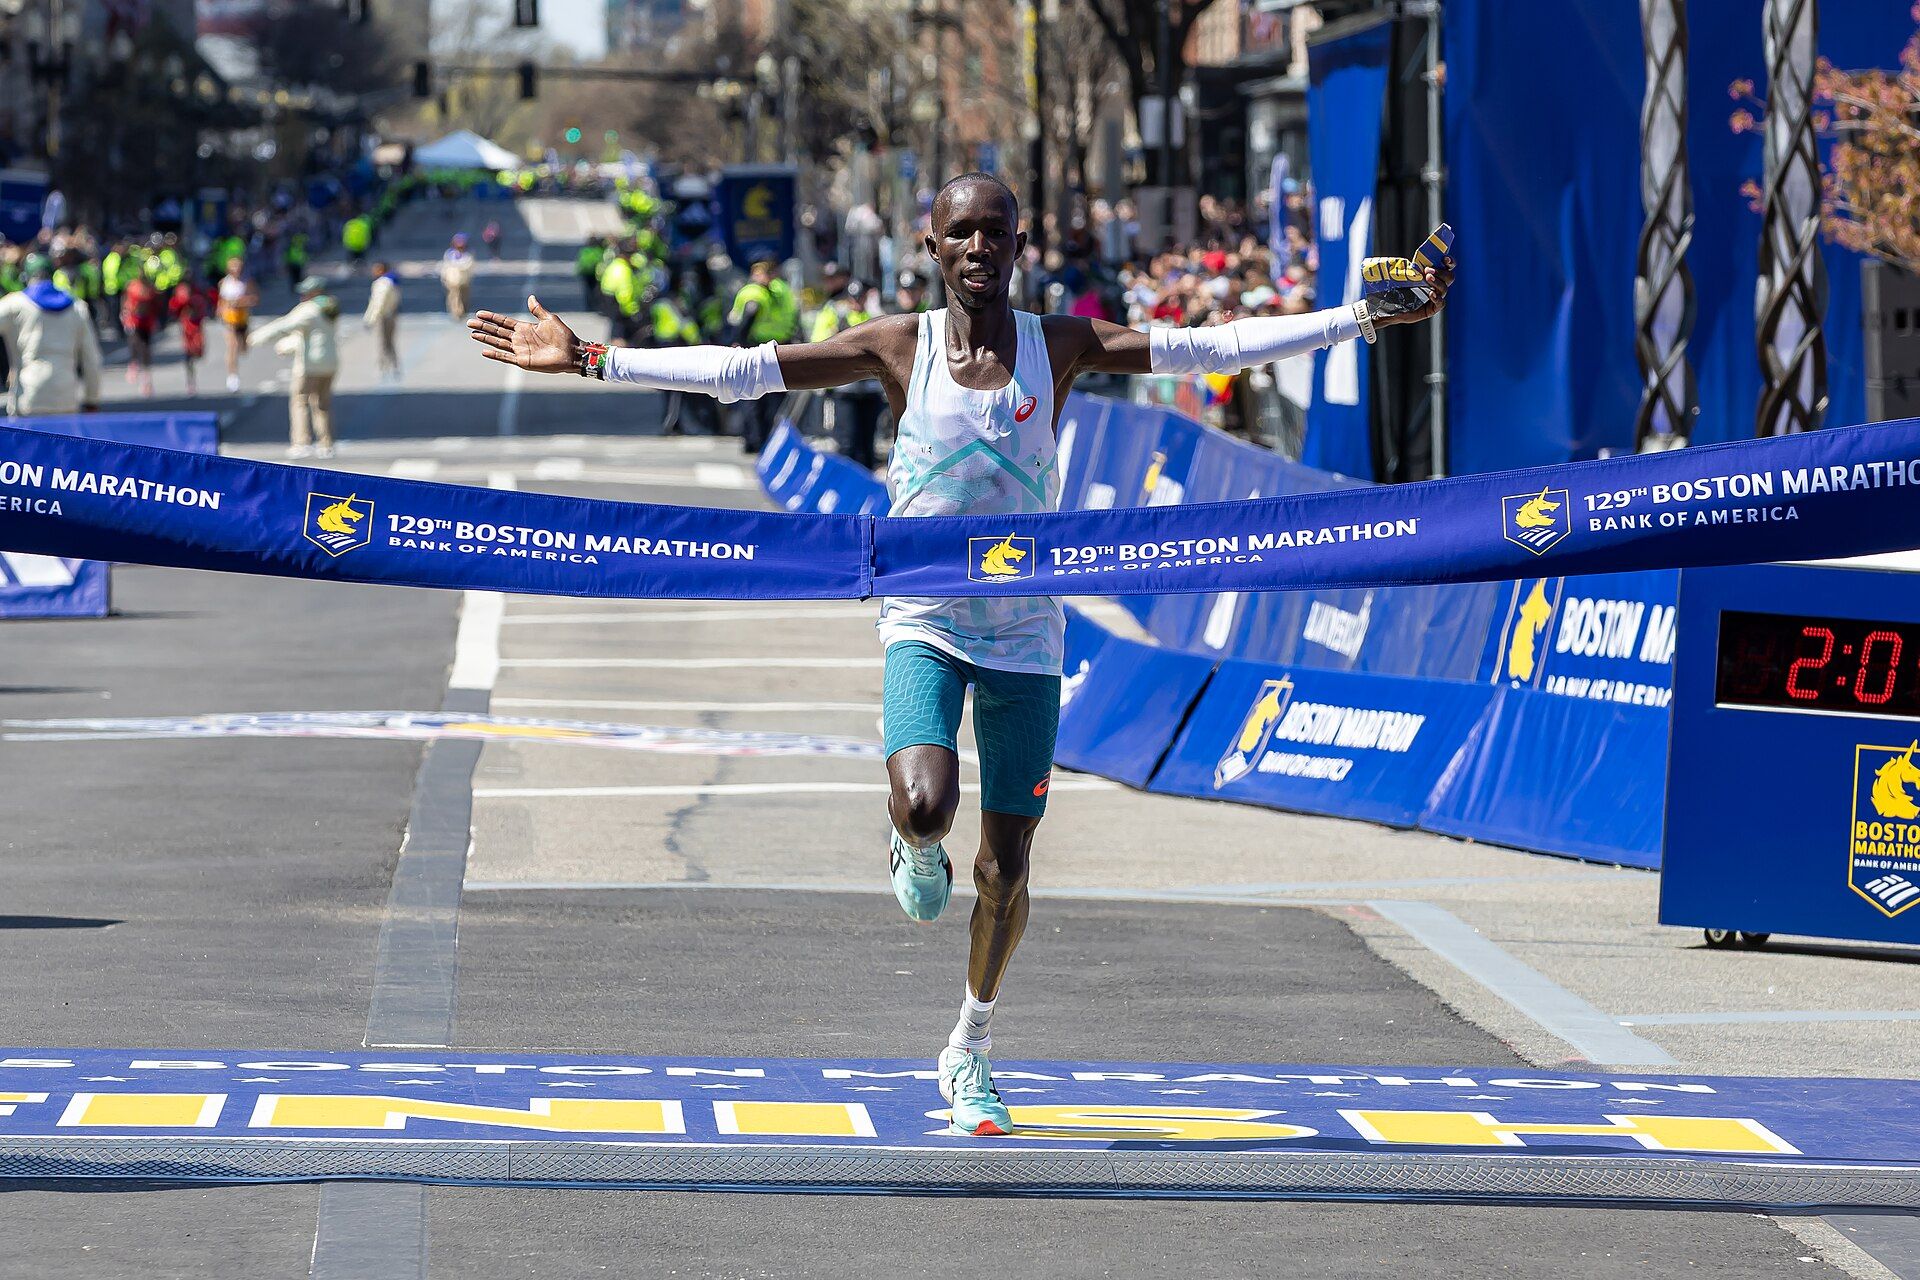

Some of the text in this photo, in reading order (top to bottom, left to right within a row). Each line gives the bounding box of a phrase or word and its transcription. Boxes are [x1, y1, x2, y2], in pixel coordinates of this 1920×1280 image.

[0, 461, 220, 510] ON MARATHON
[1583, 459, 1920, 511] 129TH BOSTON MARATHO
[387, 514, 755, 561] 129TH BOSTON MARATHON
[1050, 518, 1418, 566] 129TH BOSTON MARATHON
[1589, 506, 1799, 532] BANK OF AMERICA
[388, 536, 599, 565] BANK OF AMERICA
[1053, 554, 1264, 576] BANK OF AMERICA
[1555, 597, 1645, 659] BOSTON
[1785, 627, 1904, 704] 2:0
[1854, 858, 1879, 868] BANK
[1880, 860, 1893, 869] OF
[128, 1060, 766, 1078] BOSTON
[821, 1069, 1717, 1094] MARATHON
[0, 1092, 1805, 1155] INISH
